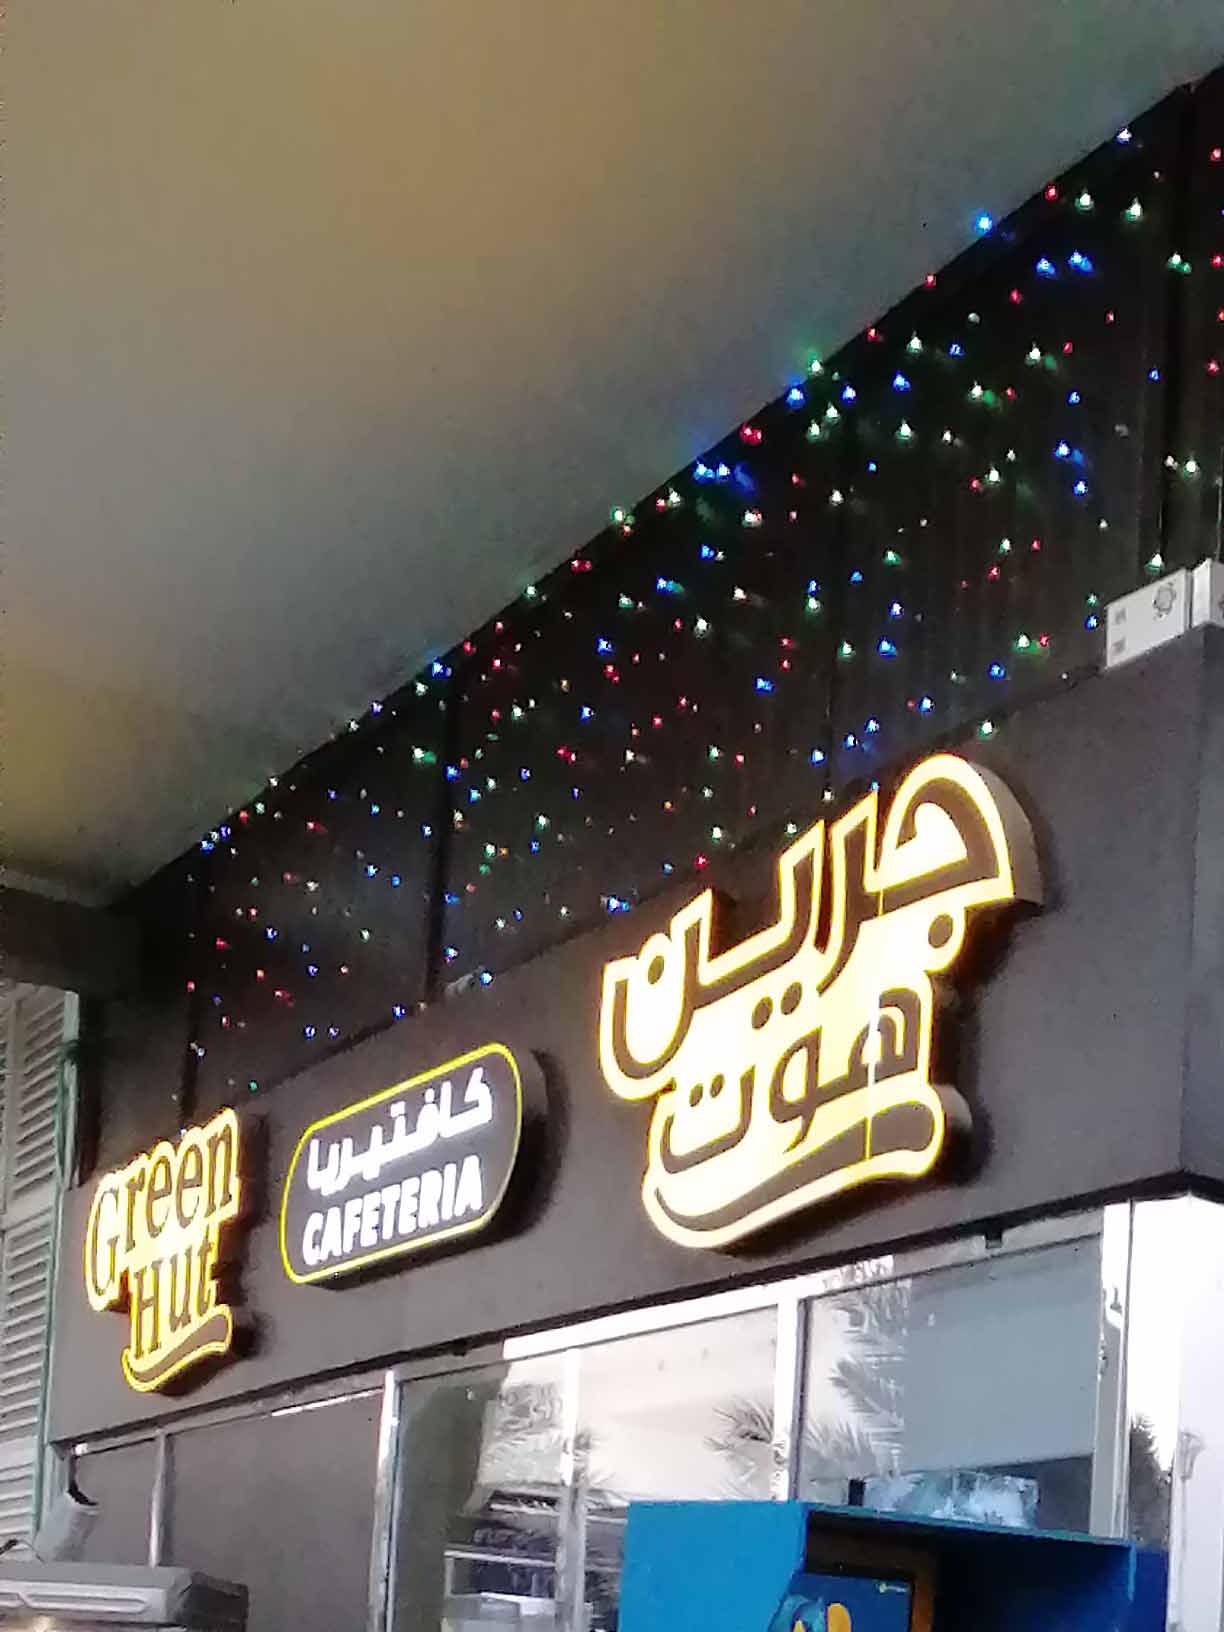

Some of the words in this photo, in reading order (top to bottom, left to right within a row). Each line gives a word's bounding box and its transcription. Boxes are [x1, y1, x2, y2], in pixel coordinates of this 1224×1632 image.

[612, 776, 1000, 1081] جرين
[306, 1066, 493, 1197] كافتيريا
[659, 986, 922, 1174] هوت
[91, 1122, 234, 1297] Green
[302, 1154, 483, 1267] CAFETERIA
[132, 1220, 216, 1360] Hut
